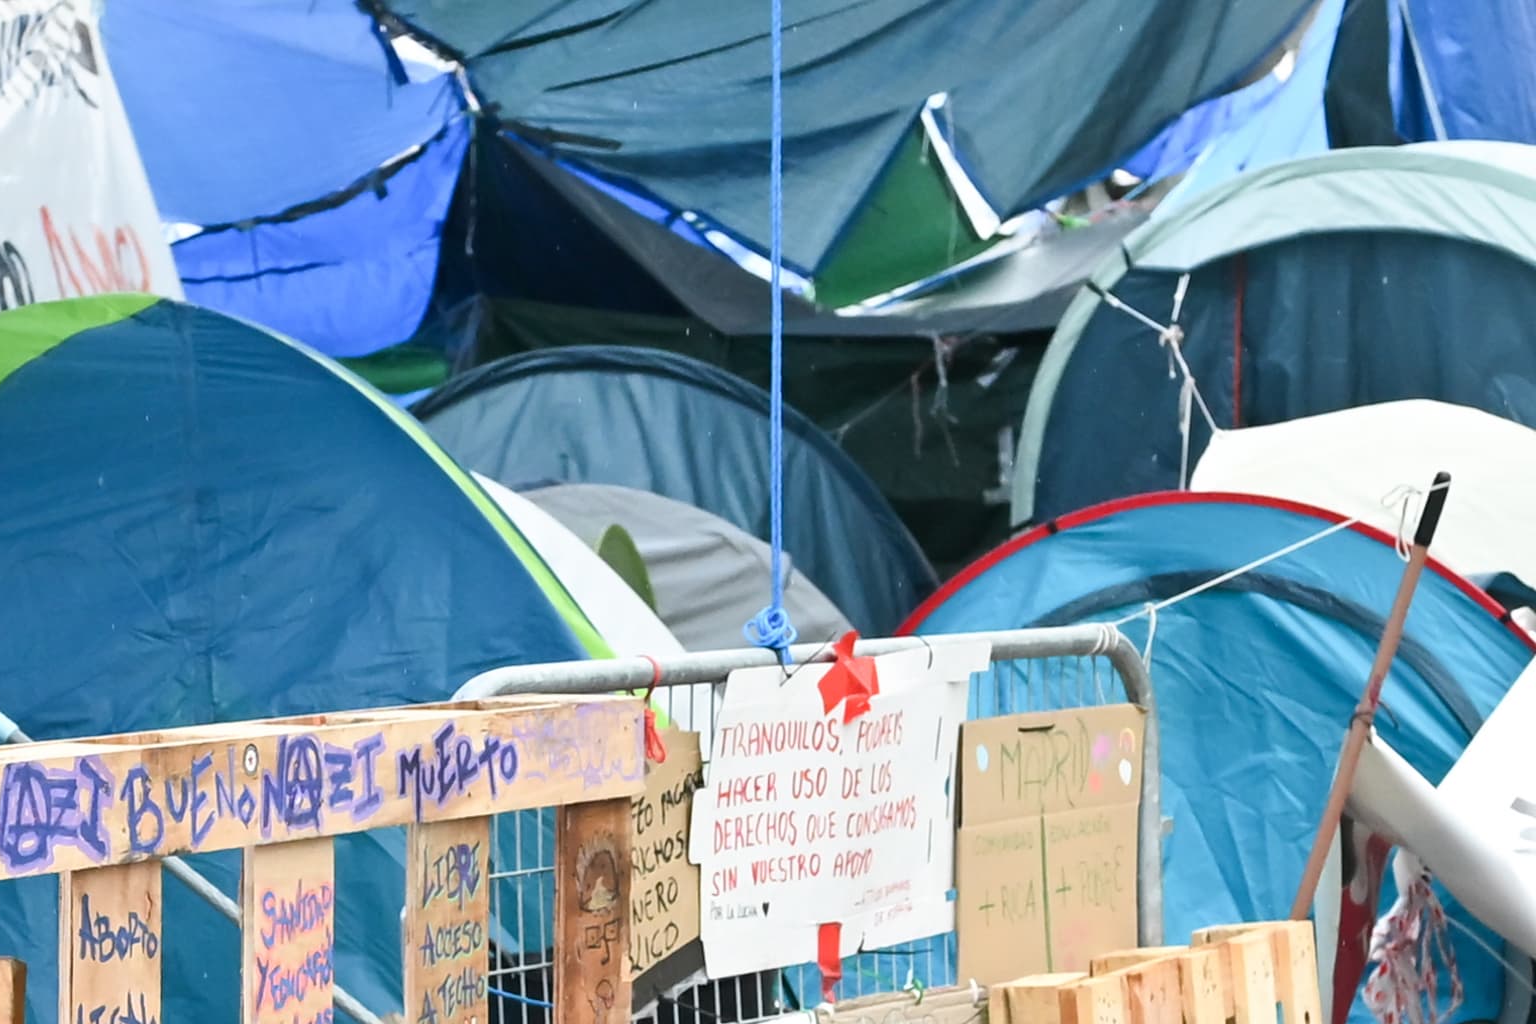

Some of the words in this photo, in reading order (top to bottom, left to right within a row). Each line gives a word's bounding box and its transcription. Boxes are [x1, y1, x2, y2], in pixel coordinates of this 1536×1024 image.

[120, 746, 257, 853] BUENO
[261, 733, 385, 836] NAZI
[398, 720, 518, 822] MUERTO
[717, 772, 777, 808] HACER
[792, 767, 828, 799] USO
[841, 767, 863, 799] DE
[871, 760, 892, 794] LOS
[714, 810, 797, 854] DERECHOS
[806, 811, 836, 840] QUE
[422, 841, 482, 910] LIBRE
[712, 866, 738, 897] SIN
[751, 853, 821, 885] VUESTRO
[79, 893, 158, 963] ABORTO
[439, 967, 485, 1018] TECHO
